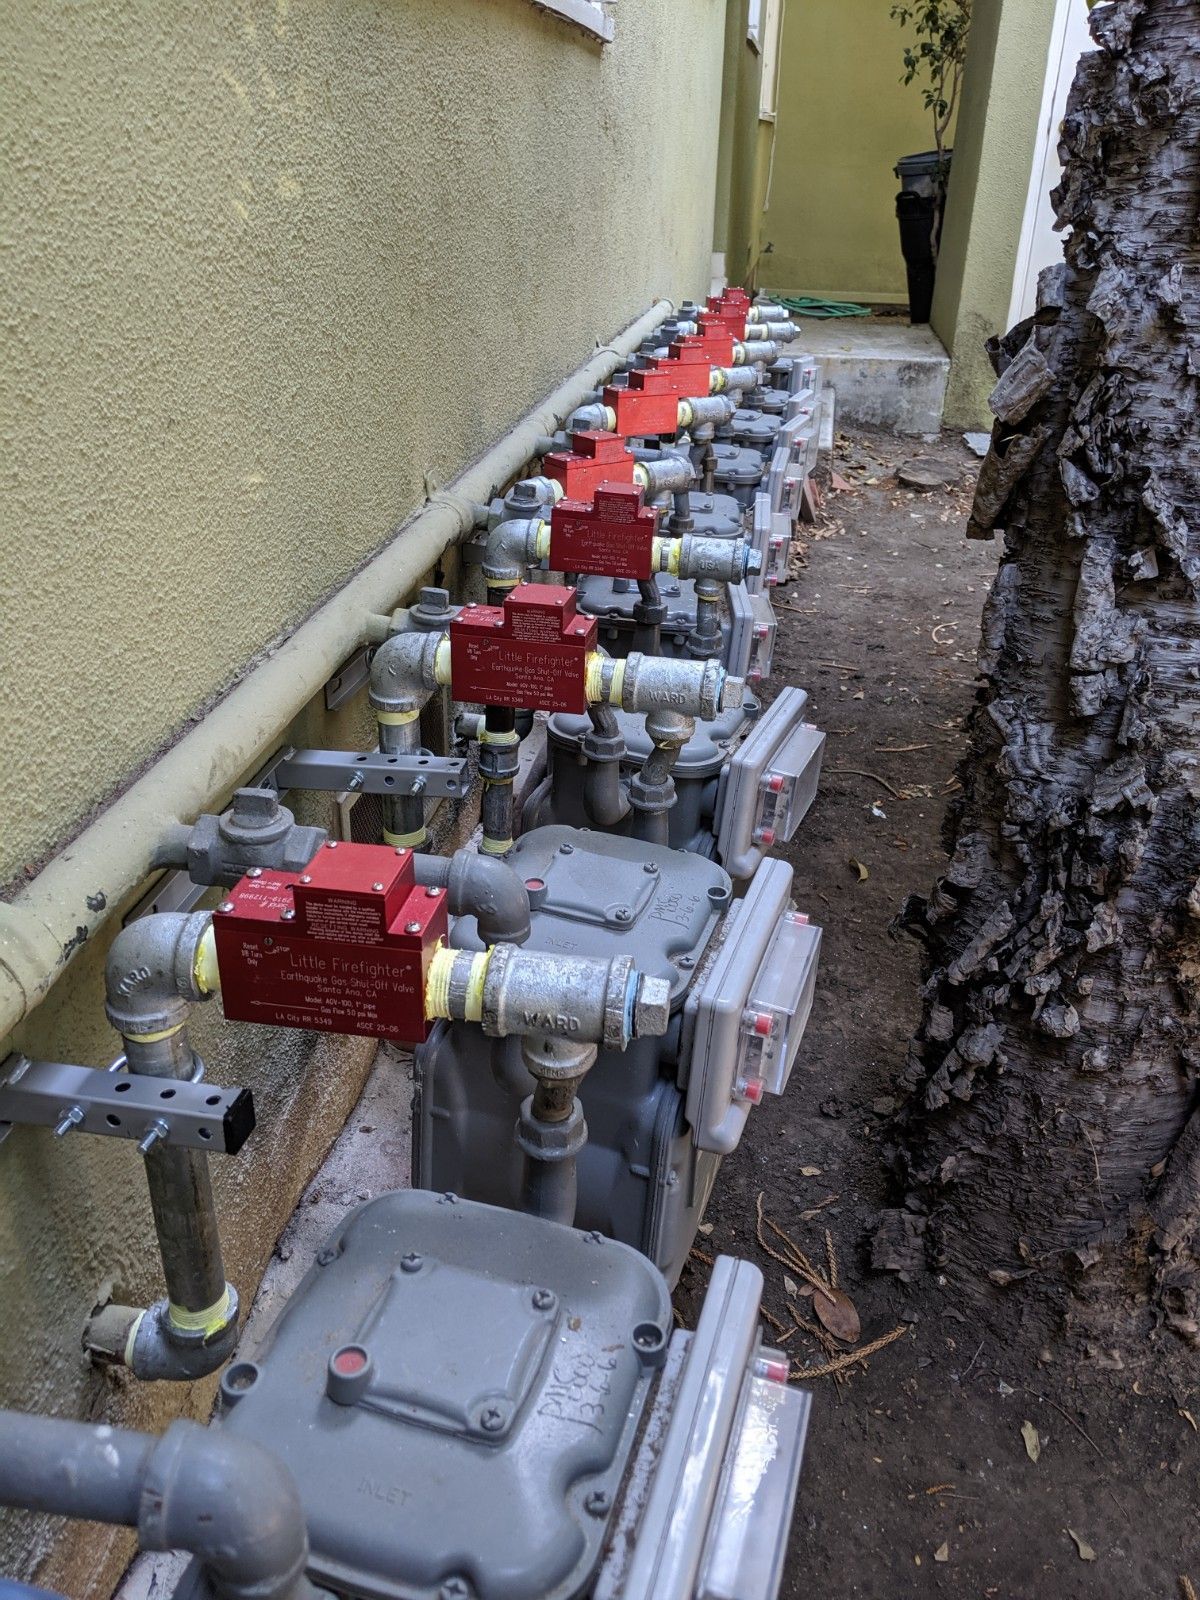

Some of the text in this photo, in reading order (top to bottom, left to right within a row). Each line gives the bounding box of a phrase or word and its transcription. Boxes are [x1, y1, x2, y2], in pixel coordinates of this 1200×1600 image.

[498, 650, 523, 662] Little
[649, 689, 686, 705] WARD
[290, 952, 326, 970] Little
[117, 966, 151, 998] WARD
[280, 970, 415, 994] Earthquake Gas Shut-Off Valve
[316, 984, 342, 994] Santa
[365, 988, 378, 998] CA
[363, 1003, 376, 1011] pipe
[275, 1011, 333, 1026] LA City RR 5349
[356, 1022, 374, 1030] ASCE
[523, 1010, 581, 1032] WARD
[357, 1476, 413, 1506] INLET
